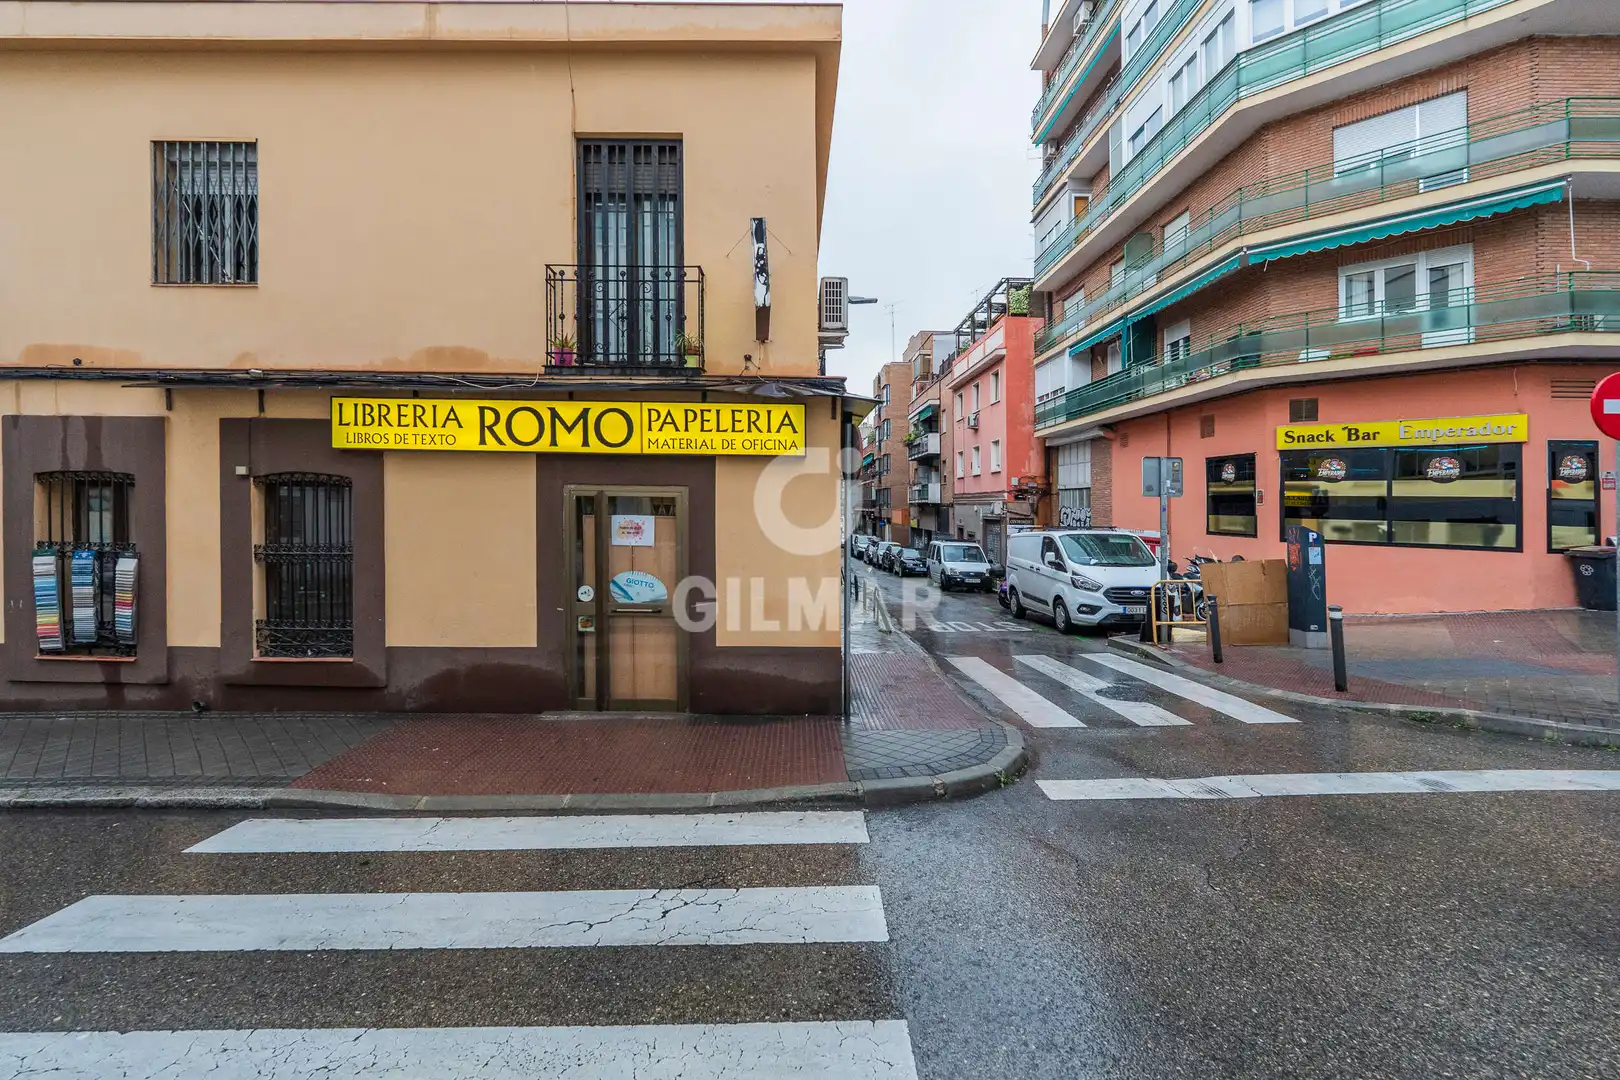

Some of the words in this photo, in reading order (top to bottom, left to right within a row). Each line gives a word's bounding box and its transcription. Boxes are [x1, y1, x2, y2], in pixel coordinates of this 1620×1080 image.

[338, 402, 464, 428] LIBRERIA
[647, 408, 799, 434] PAPELERIA
[477, 405, 634, 448] ROMO
[1284, 429, 1336, 444] Snack
[1344, 425, 1380, 442] Bar
[1399, 421, 1517, 442] Emperador
[346, 432, 389, 444] LIBROS
[394, 433, 411, 445] DE
[412, 433, 457, 446] TEXTO
[647, 437, 717, 450] MATERIAL
[721, 438, 737, 450] DE
[741, 439, 799, 451] OFICINA
[1308, 532, 1318, 543] P
[625, 577, 655, 589] GIOTTO
